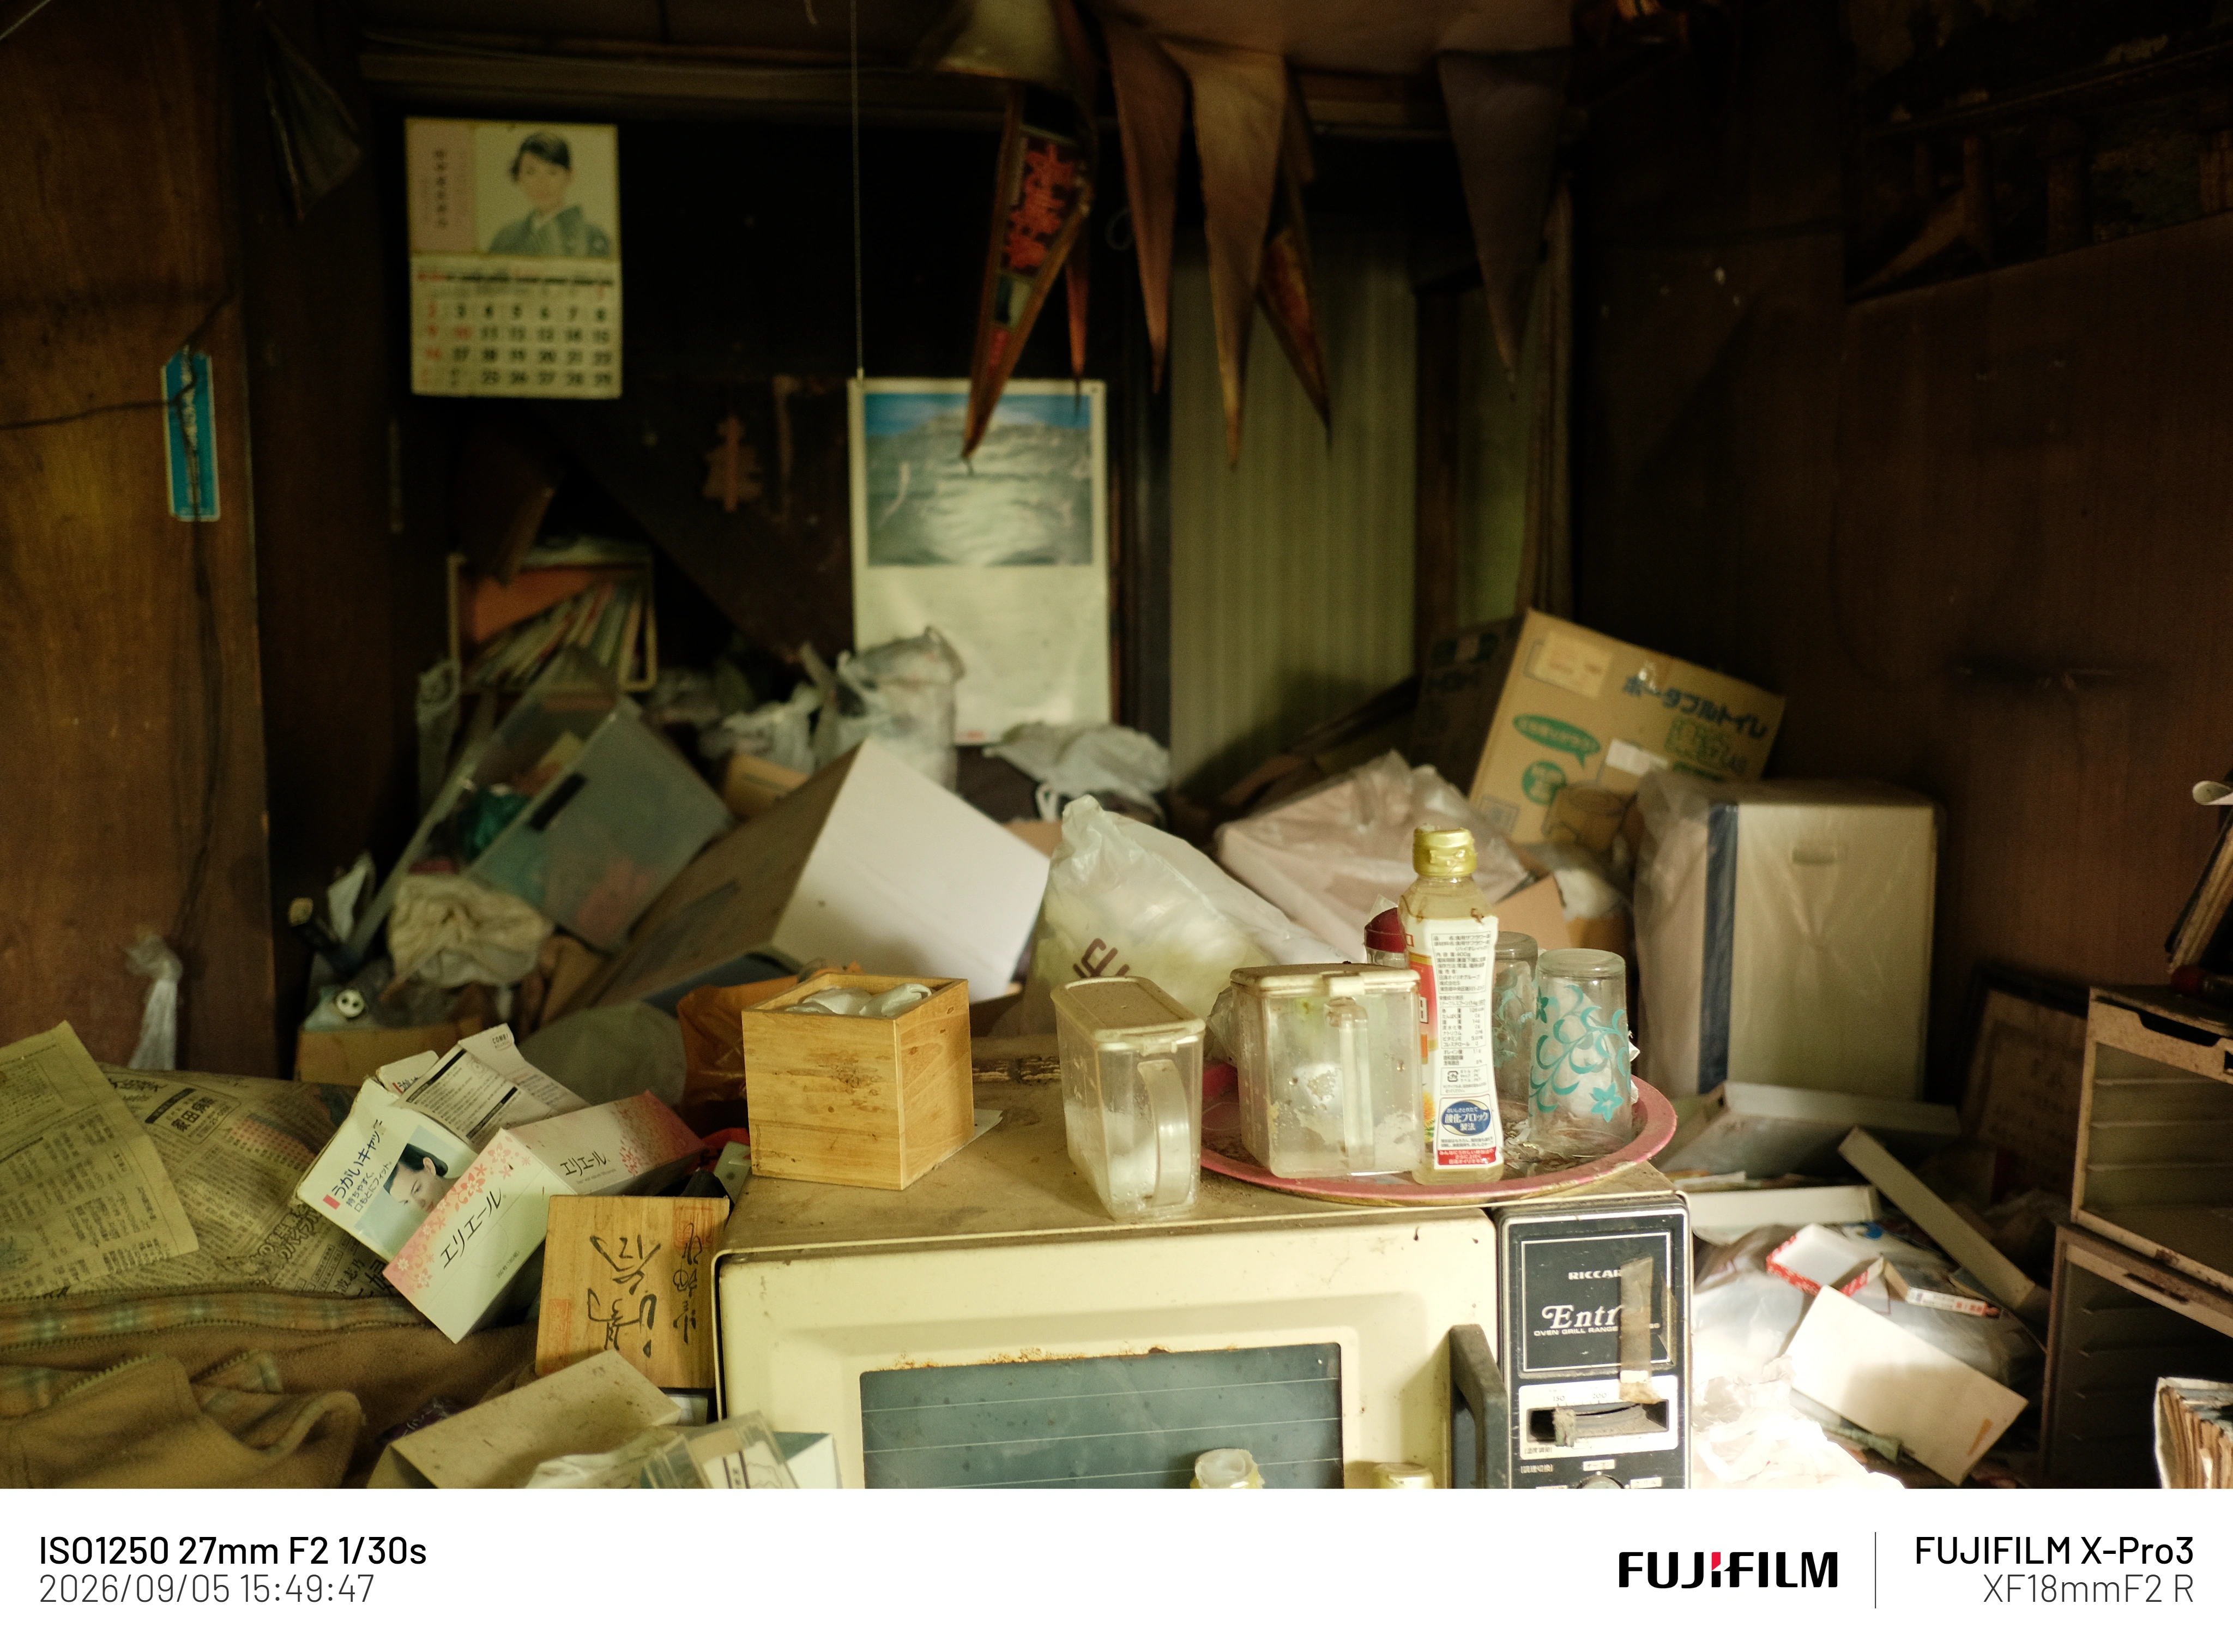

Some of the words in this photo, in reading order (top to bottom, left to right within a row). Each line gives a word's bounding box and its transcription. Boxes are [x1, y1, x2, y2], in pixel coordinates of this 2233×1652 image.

[1445, 1112, 1488, 1123] 酸化ブロック
[560, 1151, 606, 1177] エリエール
[346, 1172, 375, 1207] 持ちやすく、
[354, 1161, 392, 1213] 口もとにフィット。
[440, 1187, 502, 1270] エリエール
[1542, 1304, 1625, 1329] Entr
